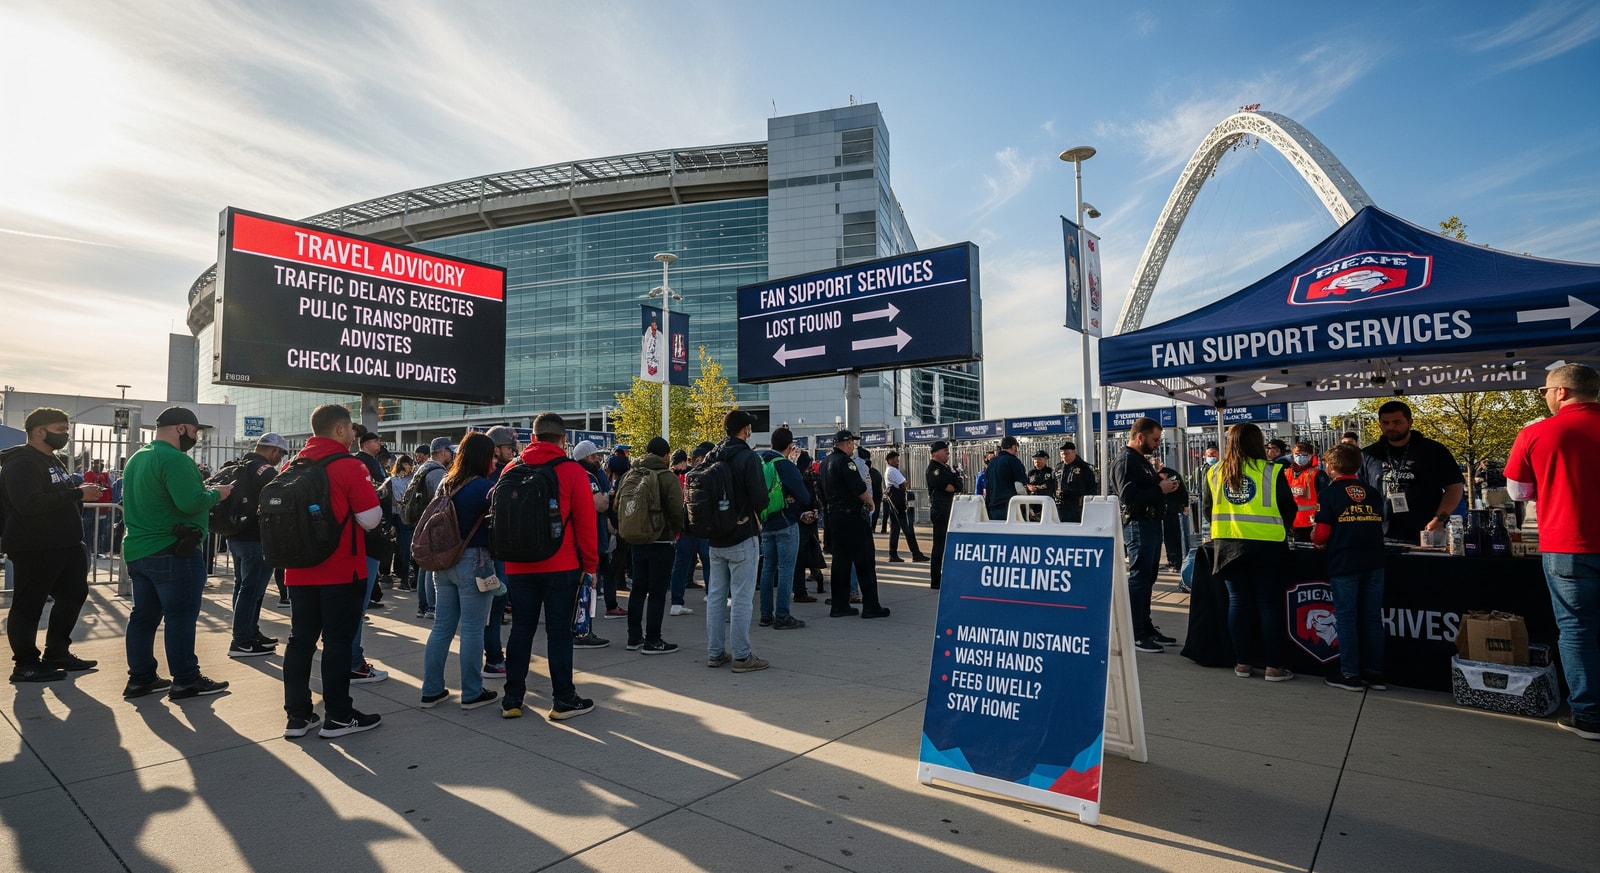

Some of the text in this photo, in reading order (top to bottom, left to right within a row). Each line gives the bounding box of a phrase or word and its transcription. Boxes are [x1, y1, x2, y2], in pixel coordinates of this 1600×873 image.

[294, 232, 466, 288] TRAVEL ADVICORY
[275, 266, 473, 317] TRAFFIC DELAYS EXEECTES
[760, 259, 933, 309] FAN SUPPORT SERVICES
[300, 297, 453, 337] PULIC TRANSPORTTE
[766, 310, 842, 339] LOST FOUND
[340, 328, 412, 354] ADVISTES
[1152, 310, 1472, 368] FAN SUPPORT SERVICES
[287, 349, 456, 385] CHECK LOCAL UPDATES
[954, 544, 1104, 568] HEALTH AND SAFETY
[981, 566, 1072, 592] GUIELINES
[957, 625, 1090, 655] MAINTAIN DISTANCE
[955, 647, 1043, 674] WASH HANDS
[986, 676, 1041, 699] UWELL?
[947, 693, 1021, 721] STAY HOME
